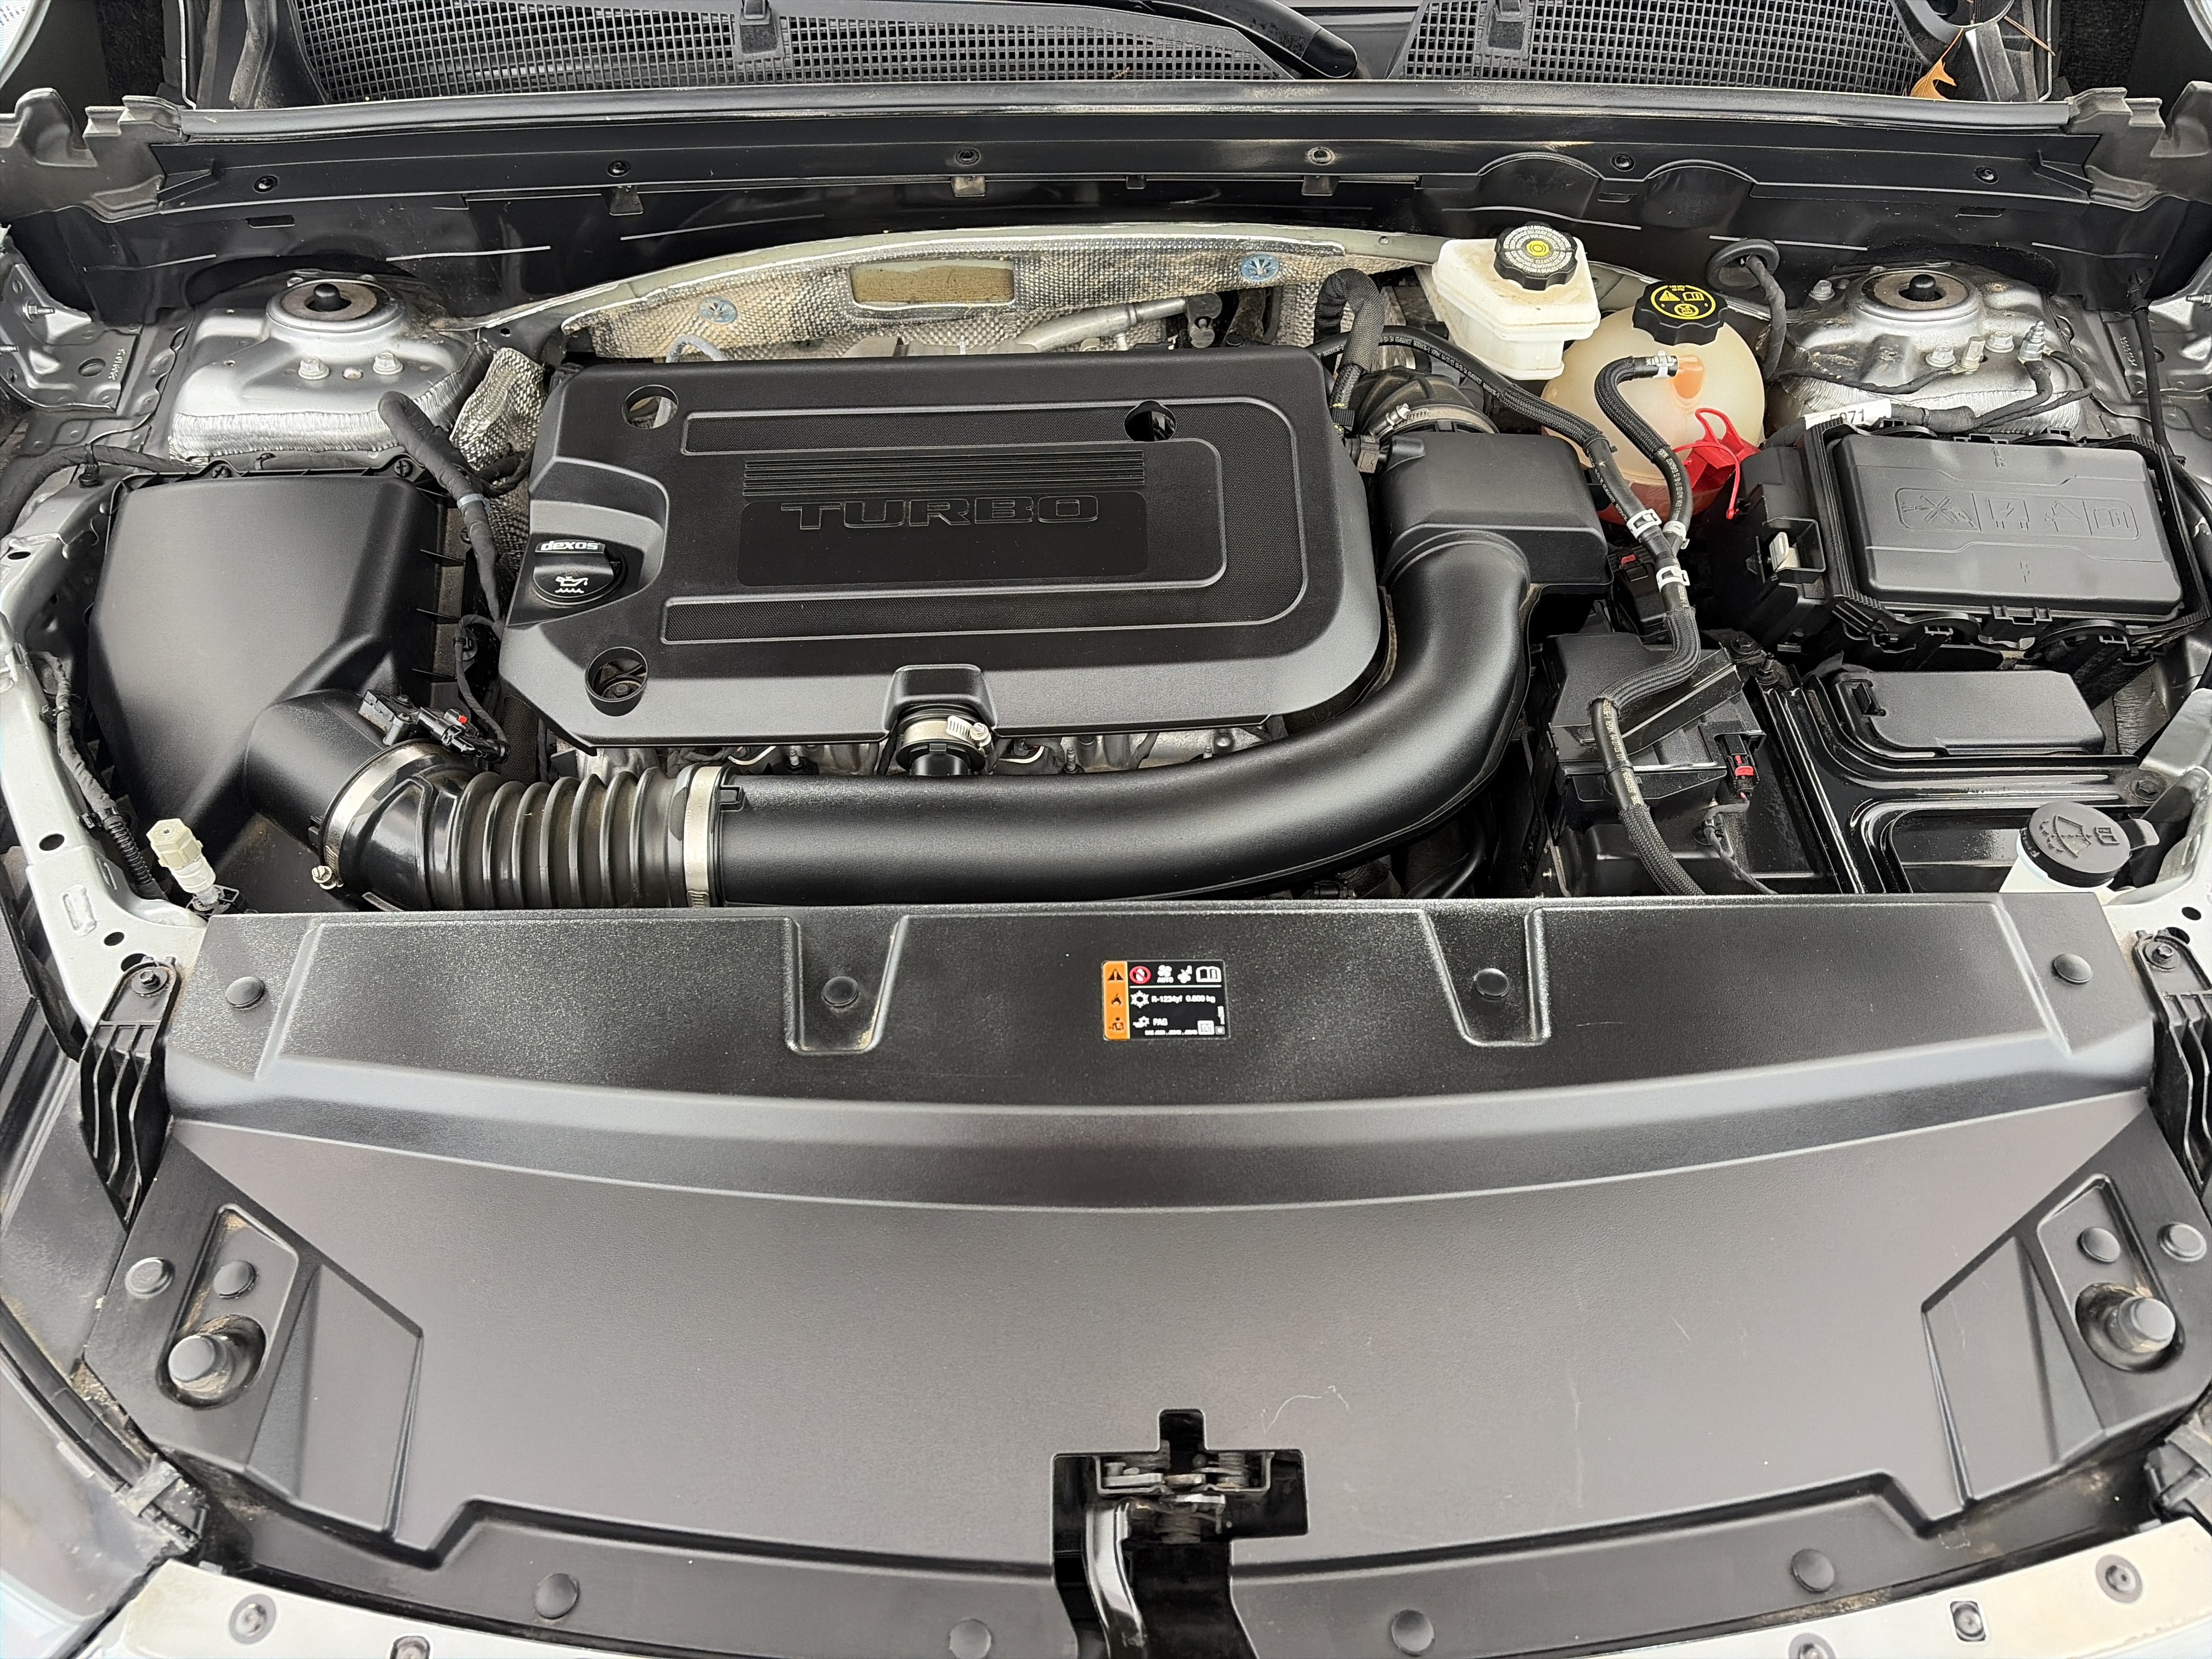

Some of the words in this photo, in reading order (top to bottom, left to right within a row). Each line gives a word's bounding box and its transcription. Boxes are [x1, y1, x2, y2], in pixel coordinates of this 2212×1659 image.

[781, 495, 1098, 530] TURBO
[540, 540, 599, 551] dexos
[1206, 995, 1216, 1003] kg
[1153, 1018, 1168, 1026] PAG
